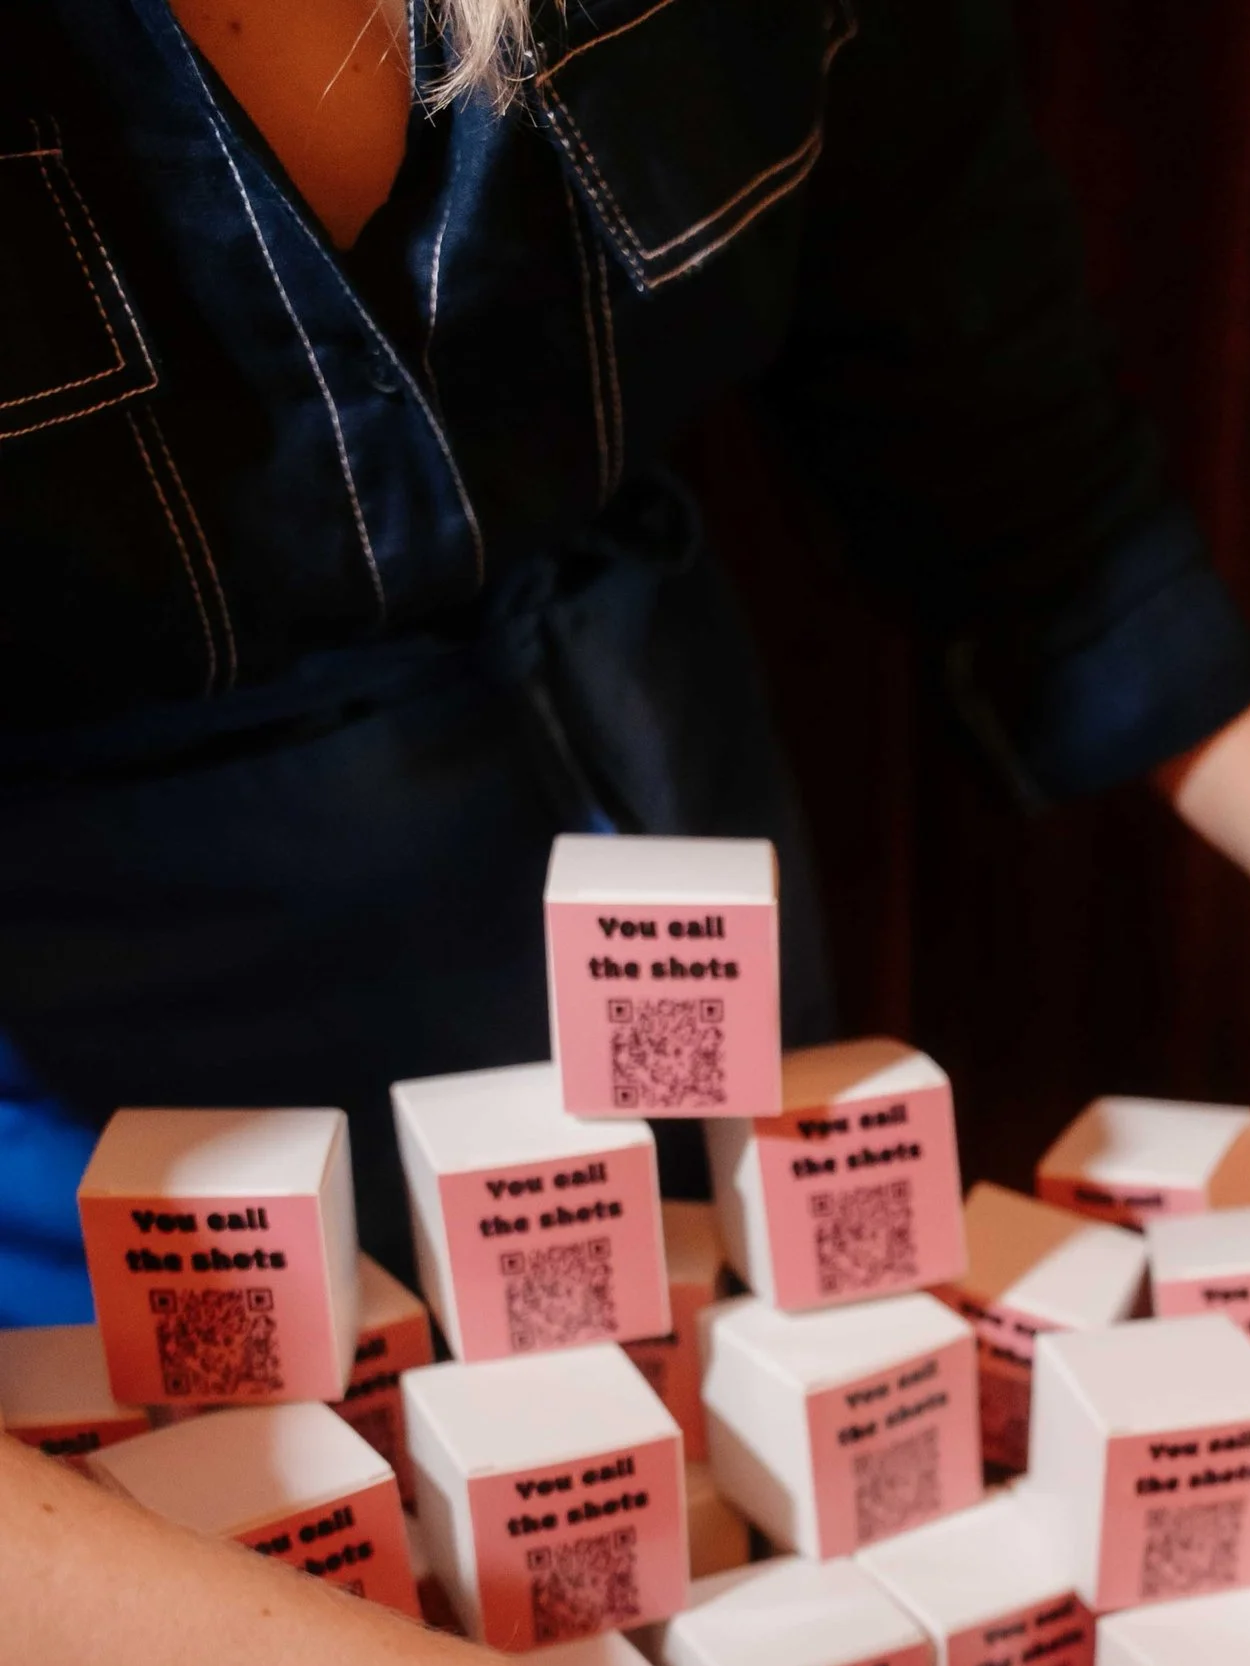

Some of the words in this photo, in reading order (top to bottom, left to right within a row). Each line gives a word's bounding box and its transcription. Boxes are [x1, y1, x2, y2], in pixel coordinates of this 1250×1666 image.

[598, 915, 657, 939] You
[668, 915, 725, 939] call
[589, 956, 640, 979] the
[651, 956, 740, 980] shots
[797, 1118, 849, 1141] You
[792, 1157, 836, 1180] the
[847, 1143, 921, 1170] shots
[486, 1176, 544, 1200] You
[553, 1162, 607, 1189] call
[131, 1209, 198, 1233] You
[207, 1207, 270, 1232] call
[480, 1215, 529, 1238] the
[540, 1201, 622, 1229] shots
[125, 1248, 183, 1273] the
[192, 1247, 287, 1272] shots
[515, 1476, 573, 1500] You
[581, 1455, 635, 1485] call
[299, 1504, 355, 1545] call
[506, 1514, 558, 1537] the
[567, 1491, 649, 1526] shots
